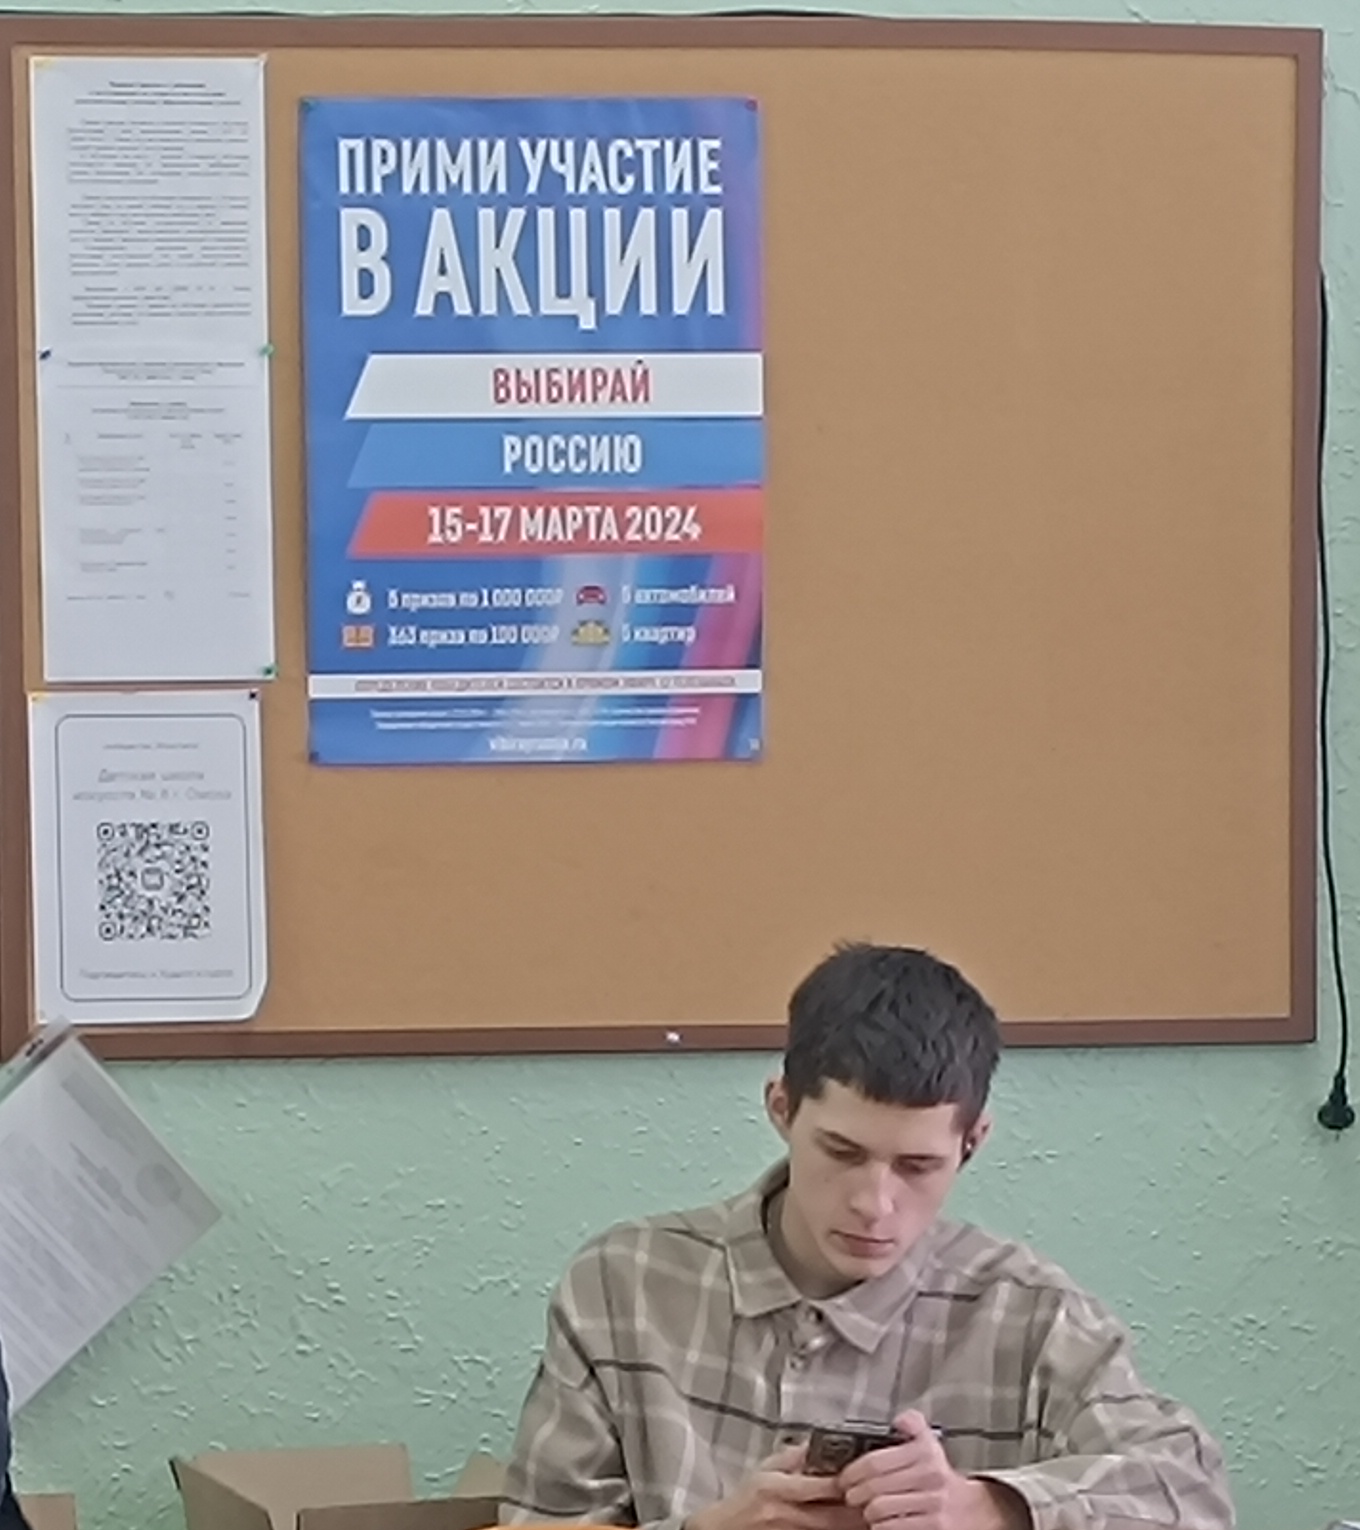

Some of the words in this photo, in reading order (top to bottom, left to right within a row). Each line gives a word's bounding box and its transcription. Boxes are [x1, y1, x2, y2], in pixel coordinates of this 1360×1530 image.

[338, 137, 507, 195] ПРИМИ
[518, 137, 723, 195] УЧАСТИЕ
[340, 206, 392, 317] В
[413, 206, 726, 331] АКЦИИ
[493, 360, 651, 405] ВЫБИРАЙ
[502, 434, 643, 474] РОССИЮ
[427, 505, 513, 545] 15-17
[519, 505, 620, 543] МАРТА
[624, 505, 702, 542] 2024
